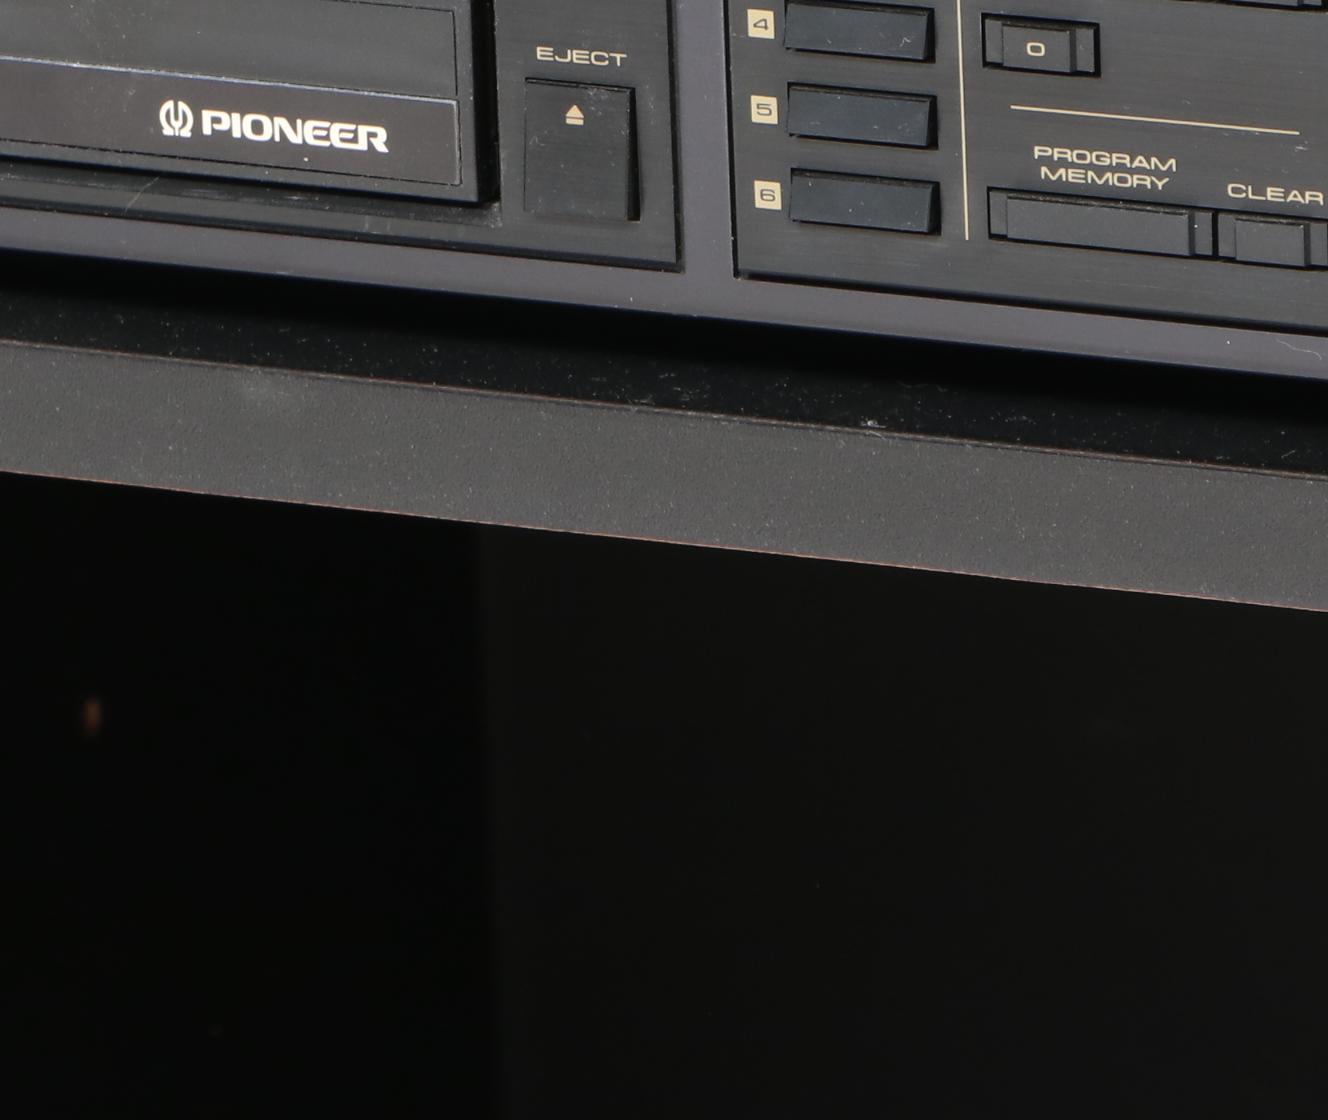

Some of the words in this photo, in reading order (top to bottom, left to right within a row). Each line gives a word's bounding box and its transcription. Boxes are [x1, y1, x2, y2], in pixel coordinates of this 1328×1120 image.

[752, 18, 769, 31] 4
[536, 46, 627, 67] EJECT
[1026, 42, 1046, 57] 0
[756, 102, 773, 117] 5
[201, 109, 389, 153] PIONEER
[1033, 145, 1177, 172] PROGRAM
[1040, 166, 1171, 191] MEMORY
[759, 188, 776, 202] 6
[1227, 183, 1324, 206] CLEAR
